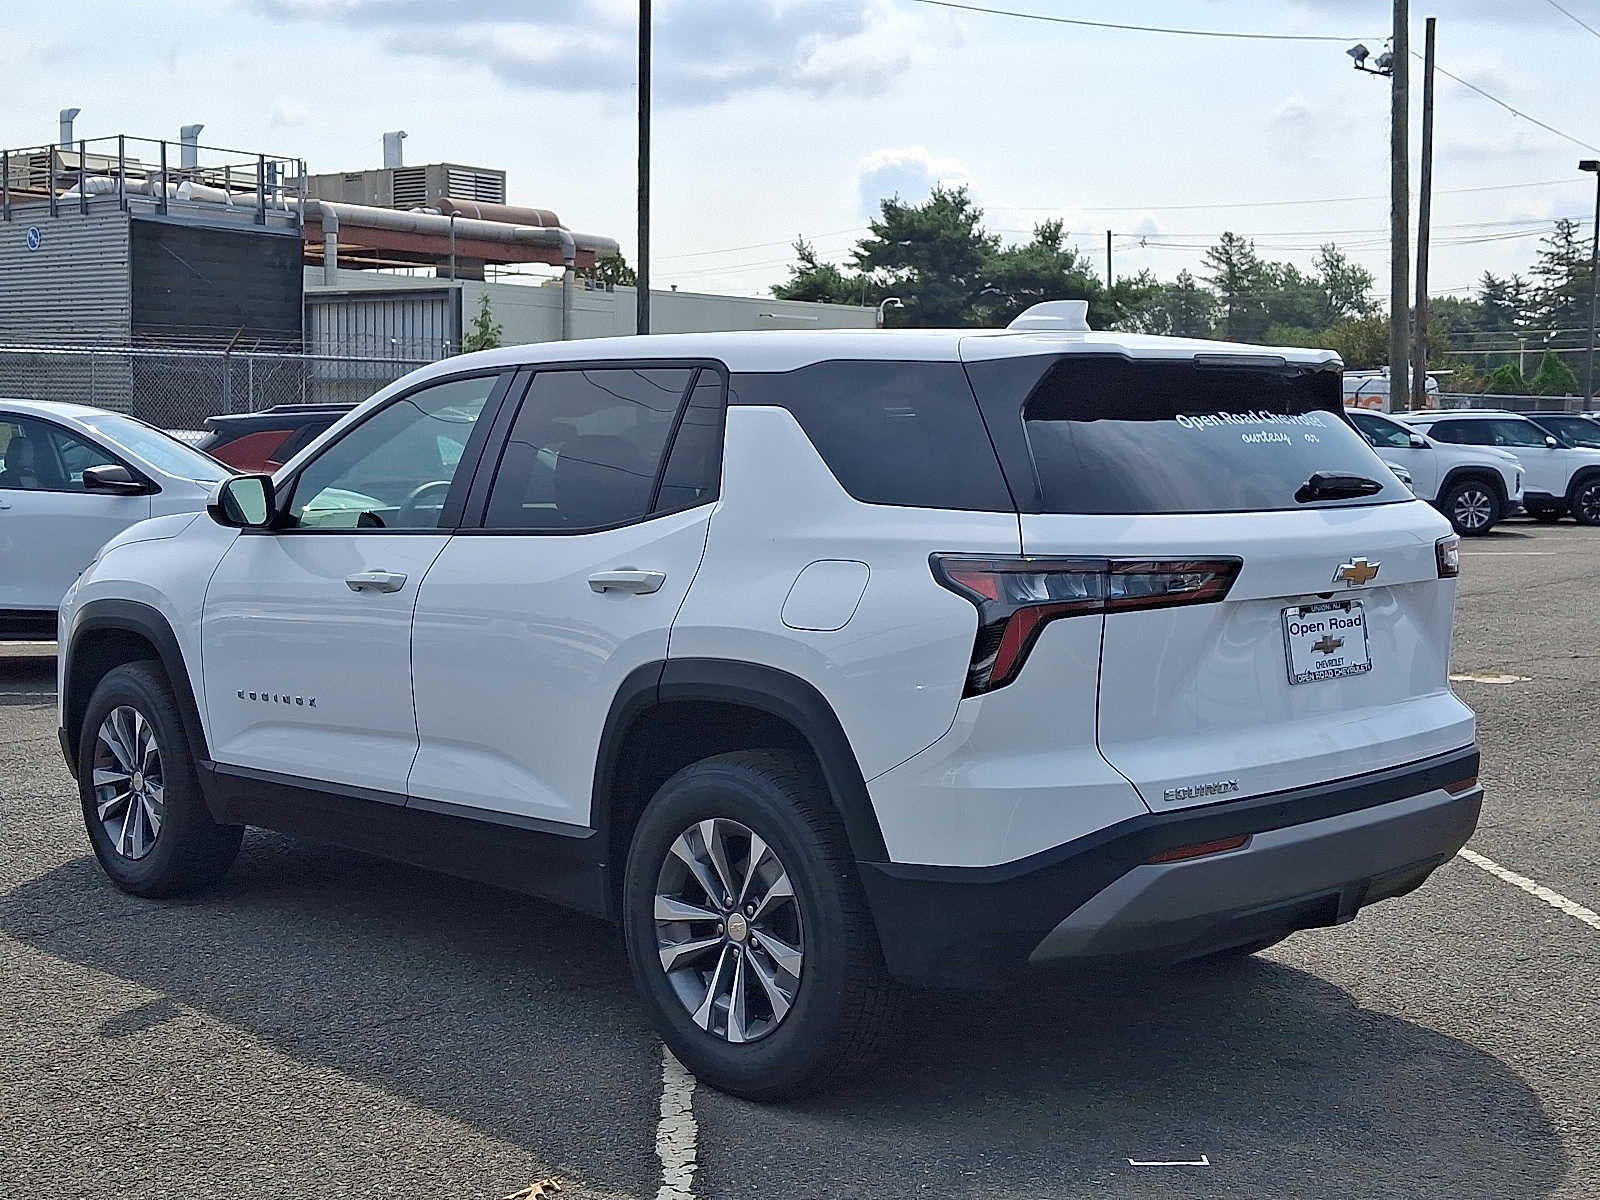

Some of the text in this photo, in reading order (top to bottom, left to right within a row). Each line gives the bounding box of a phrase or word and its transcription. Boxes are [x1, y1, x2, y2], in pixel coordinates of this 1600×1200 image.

[1175, 414, 1224, 431] Open
[1218, 410, 1262, 424] Road
[1289, 614, 1362, 637] Open Road
[1297, 673, 1315, 683] OPEN
[1315, 669, 1334, 680] ROAD
[237, 689, 317, 708] EQUINOX
[1163, 778, 1240, 802] EQUINOX
